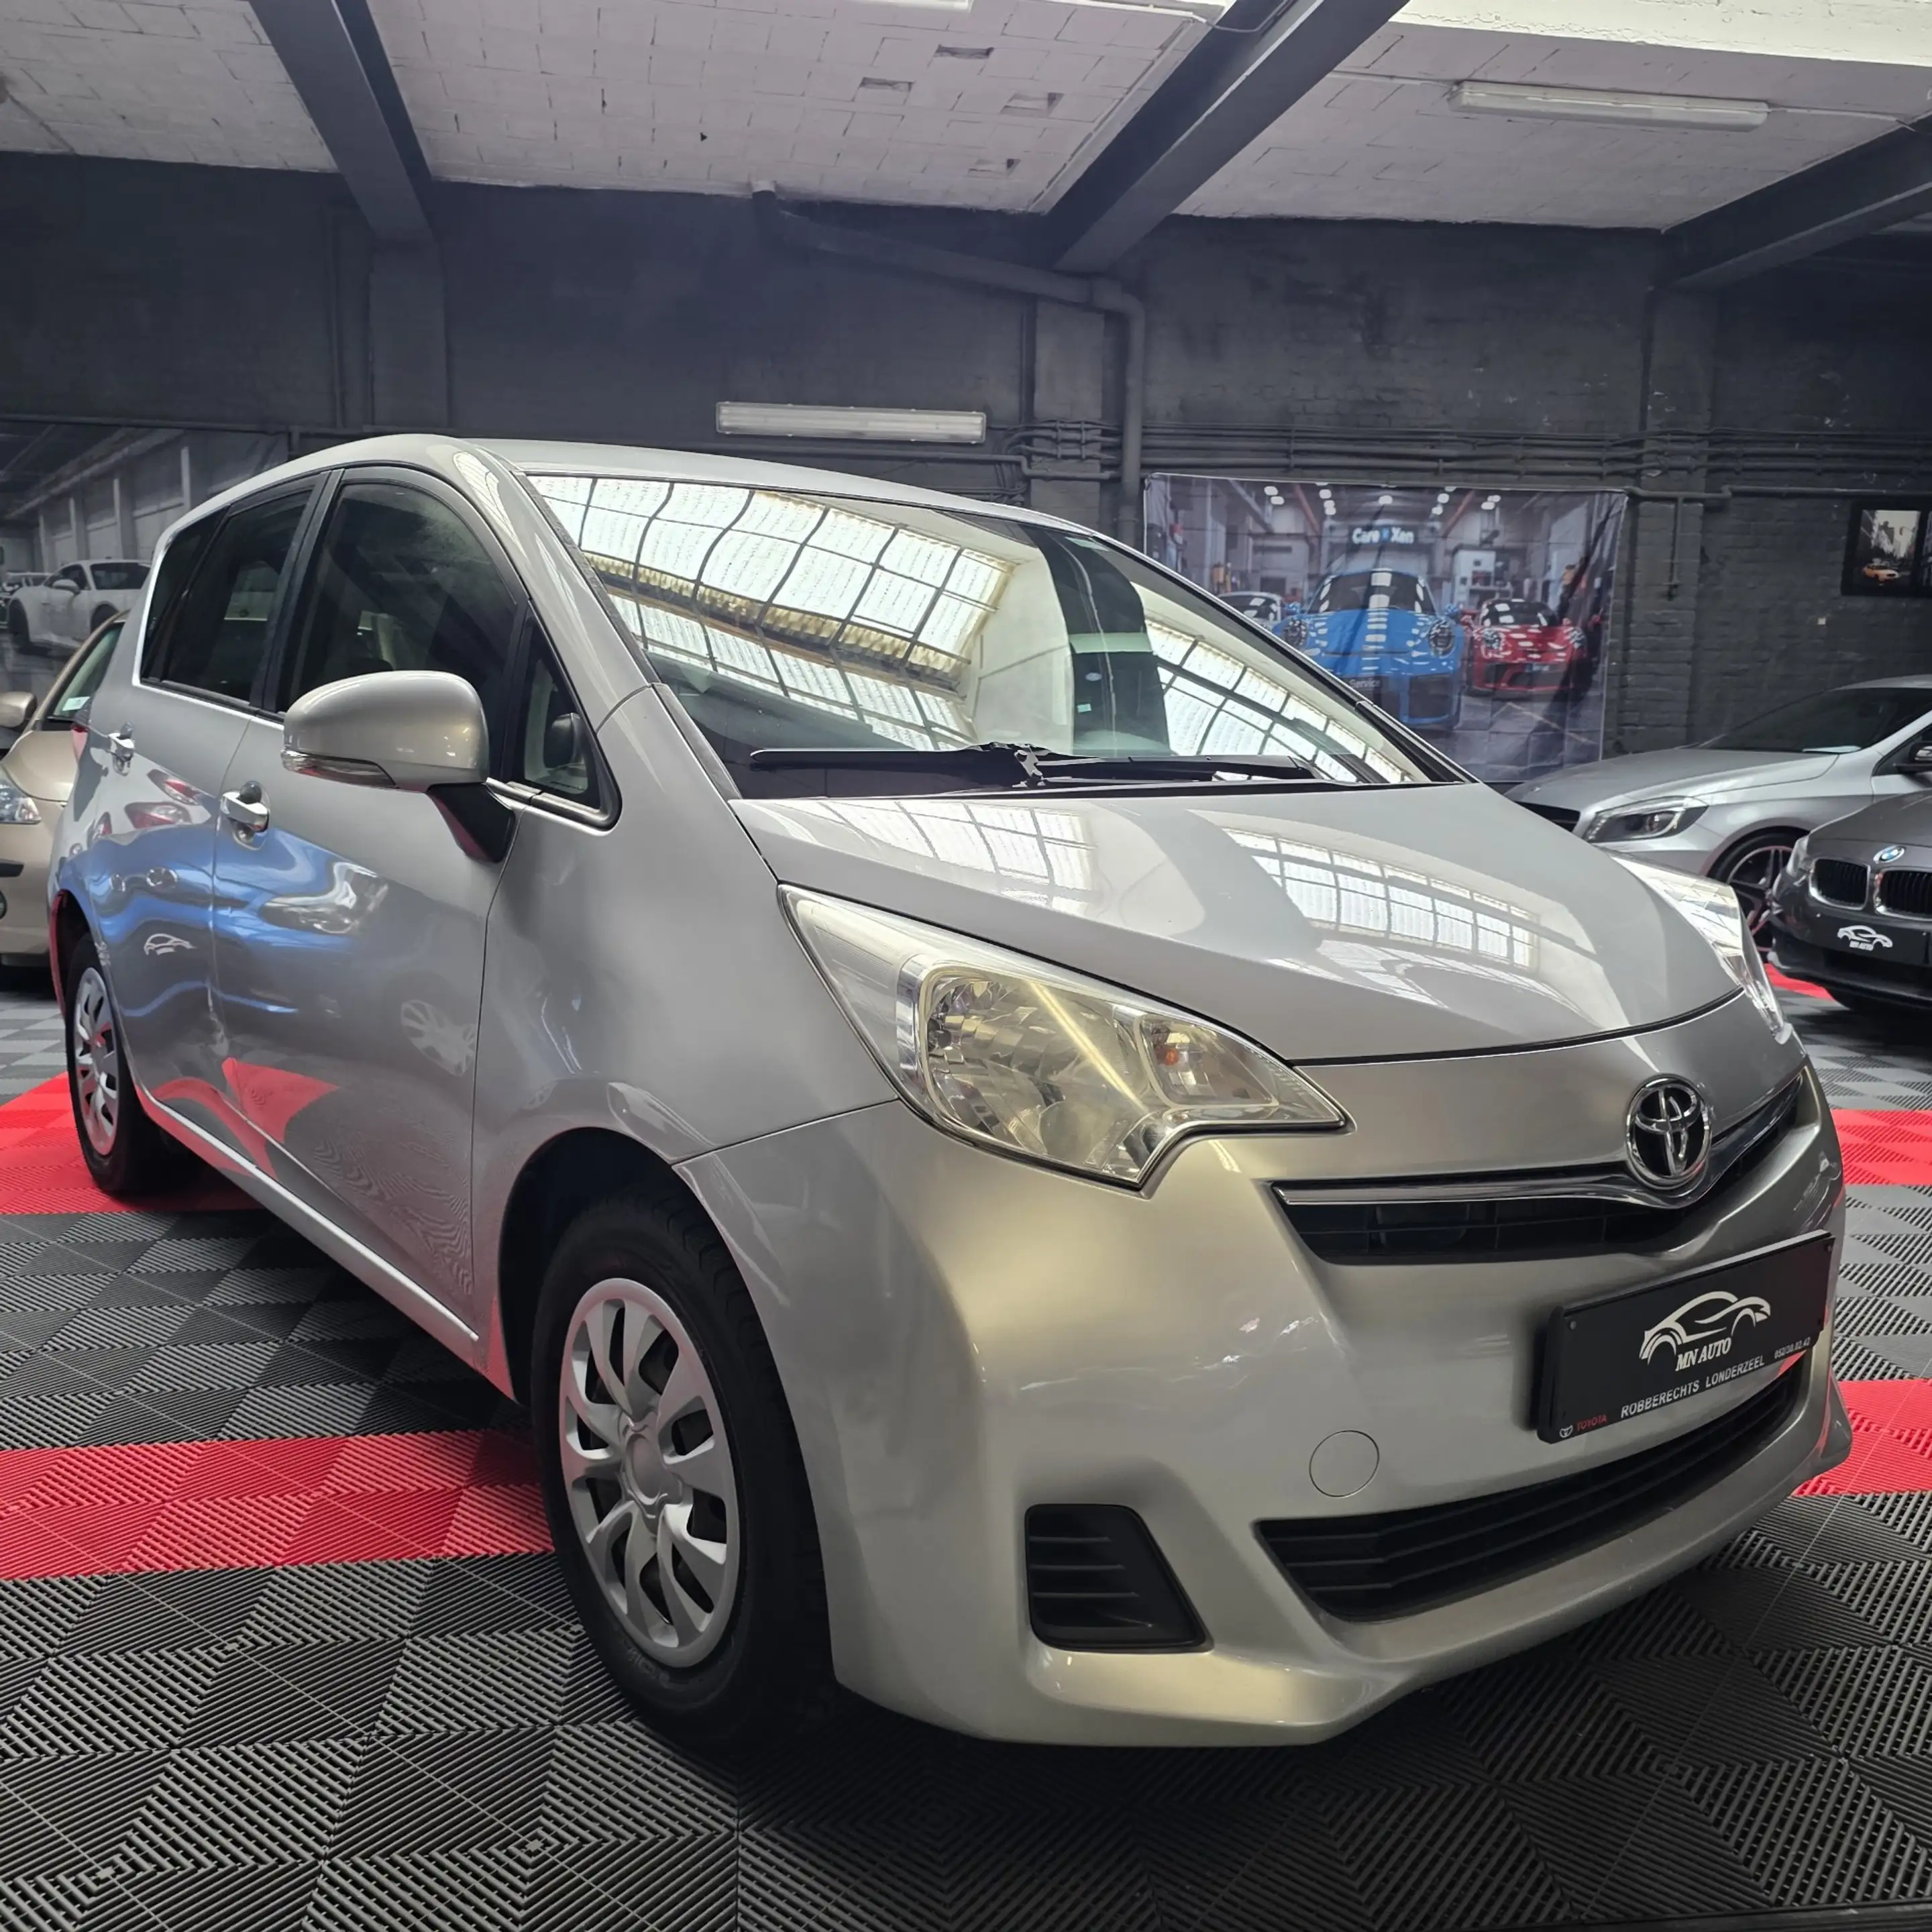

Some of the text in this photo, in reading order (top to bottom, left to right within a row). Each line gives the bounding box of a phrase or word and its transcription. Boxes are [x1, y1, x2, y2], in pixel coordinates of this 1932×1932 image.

[1675, 1337, 1732, 1371] MN AUTO
[1577, 1414, 1607, 1432] TOYOTA
[1621, 1380, 1700, 1418] ROBBERECHTS
[1705, 1354, 1765, 1388] LONDERZEEL
